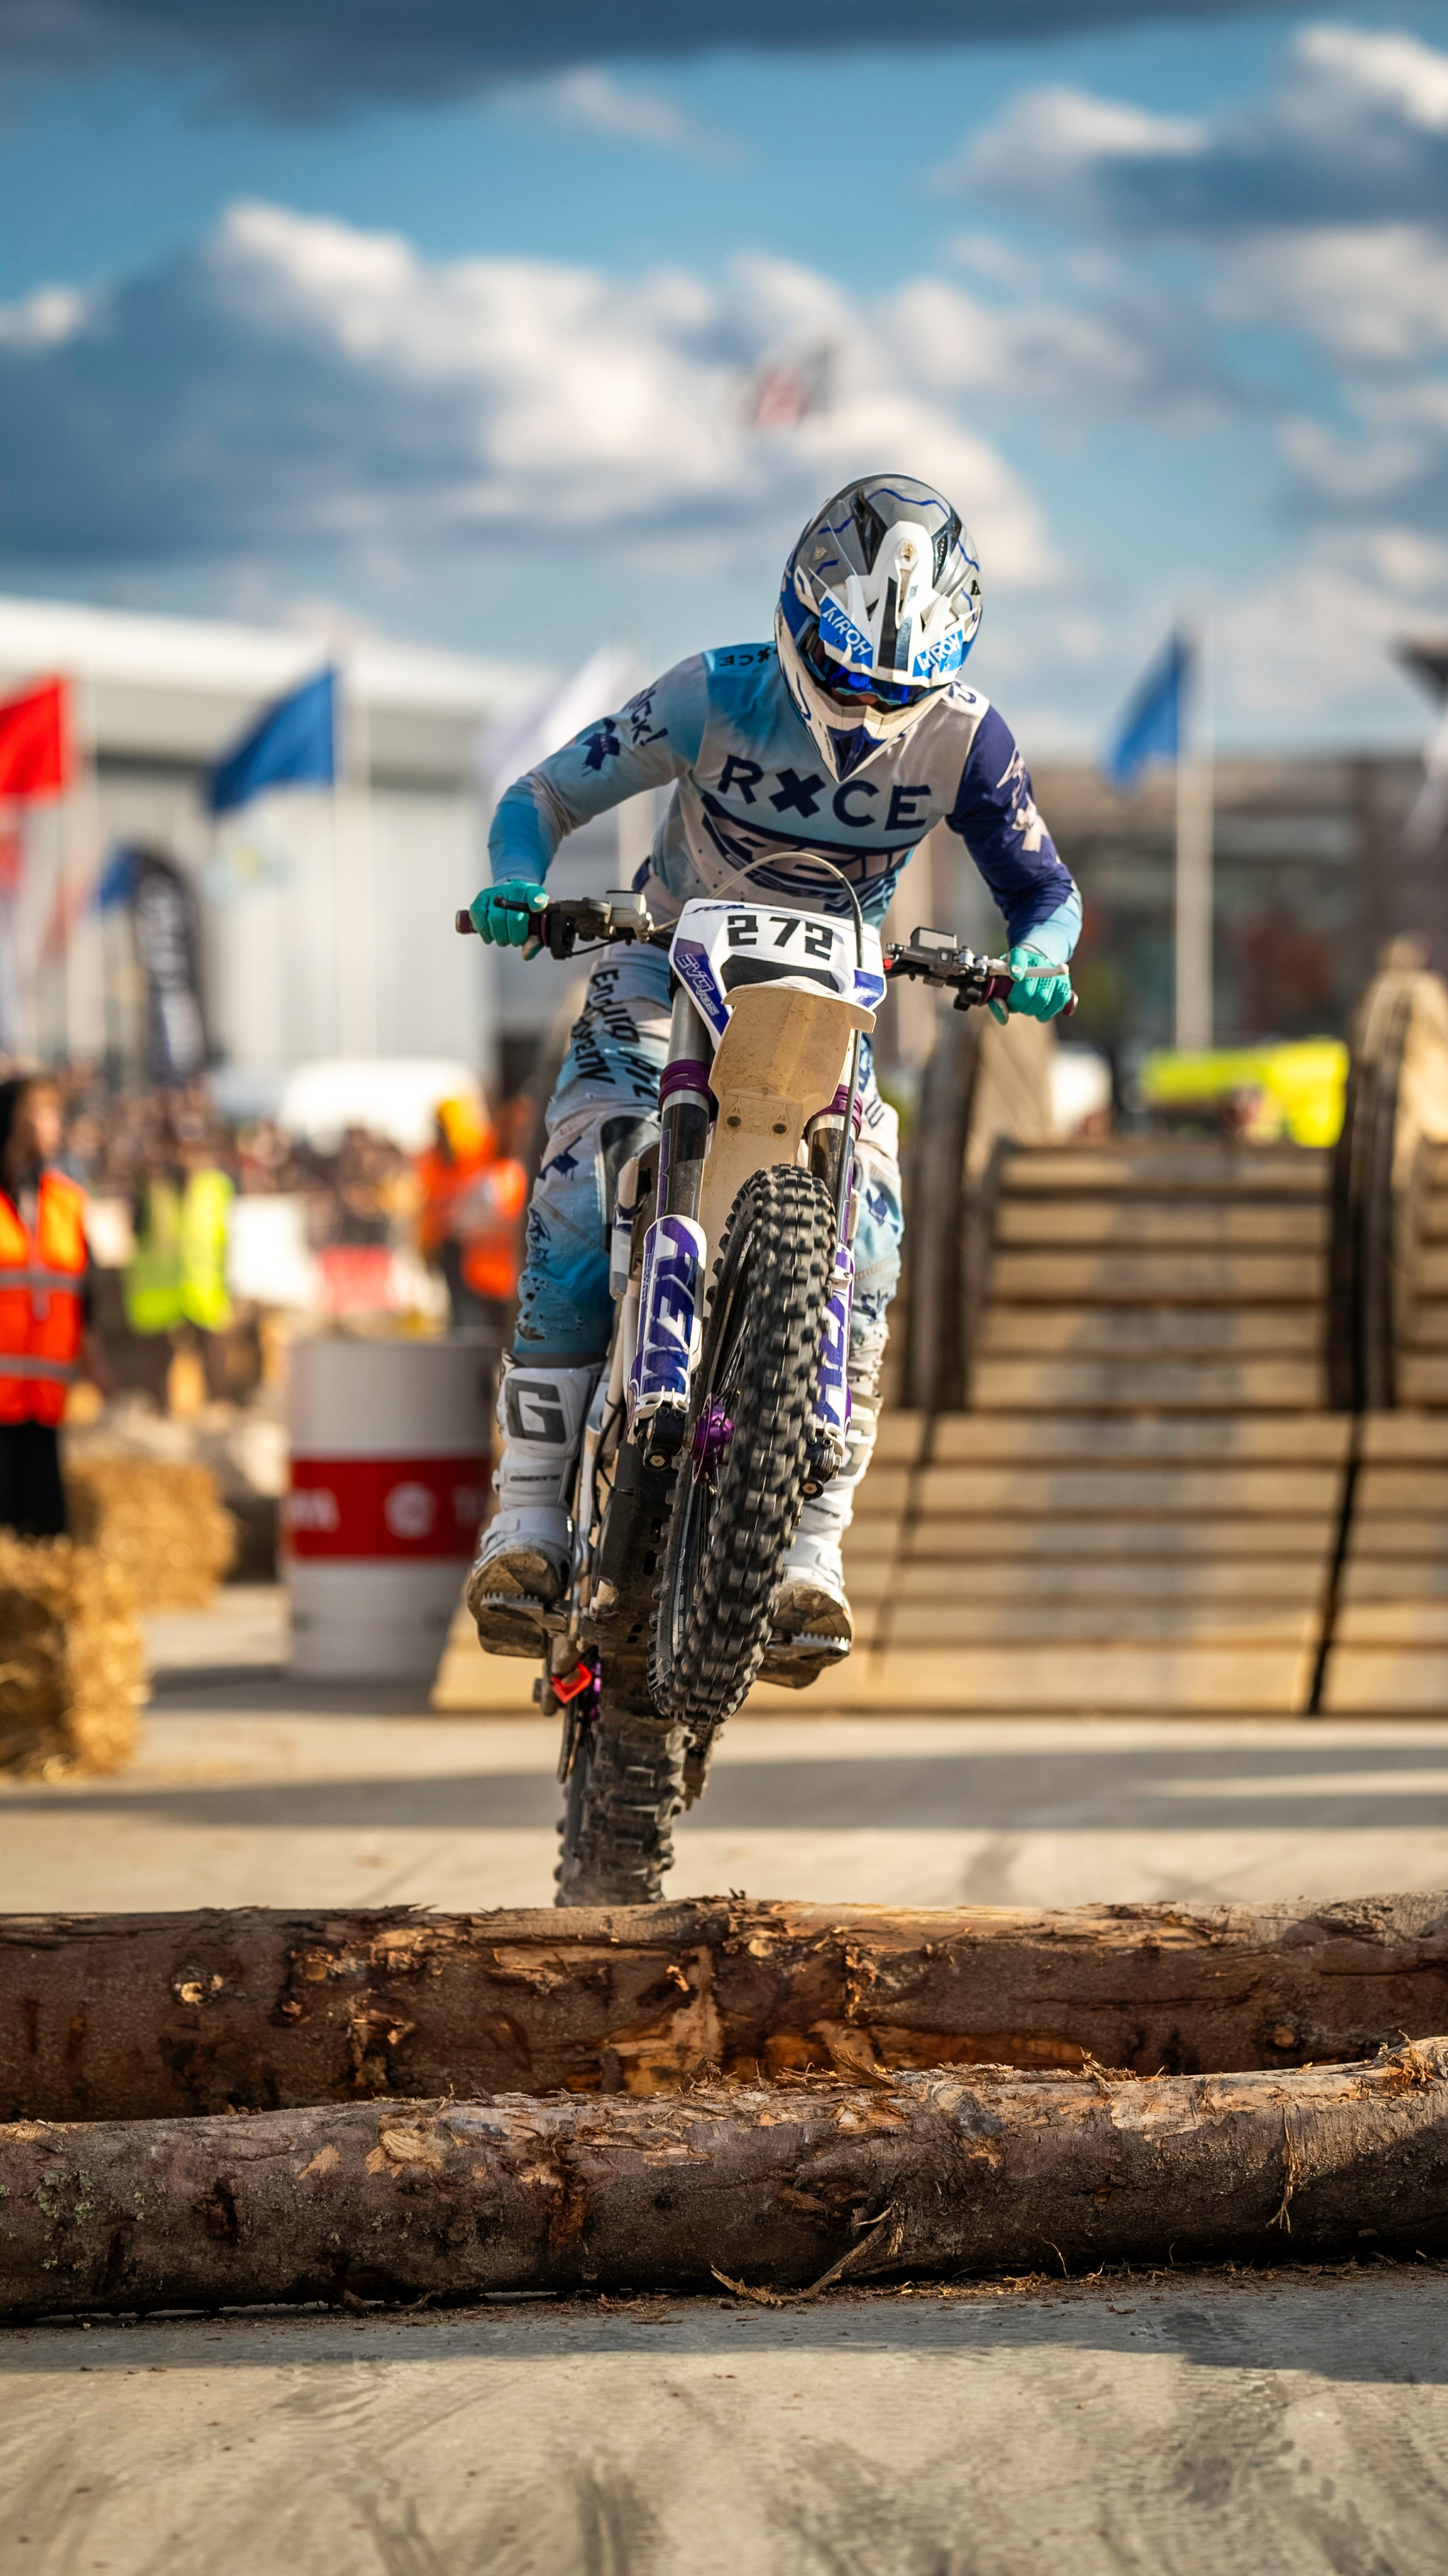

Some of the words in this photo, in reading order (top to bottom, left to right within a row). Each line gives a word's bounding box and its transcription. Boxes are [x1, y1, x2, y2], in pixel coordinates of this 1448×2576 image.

[822, 606, 872, 656] AIROH
[915, 633, 961, 672] AIROH
[727, 915, 834, 961] 272
[505, 1377, 567, 1445] G
